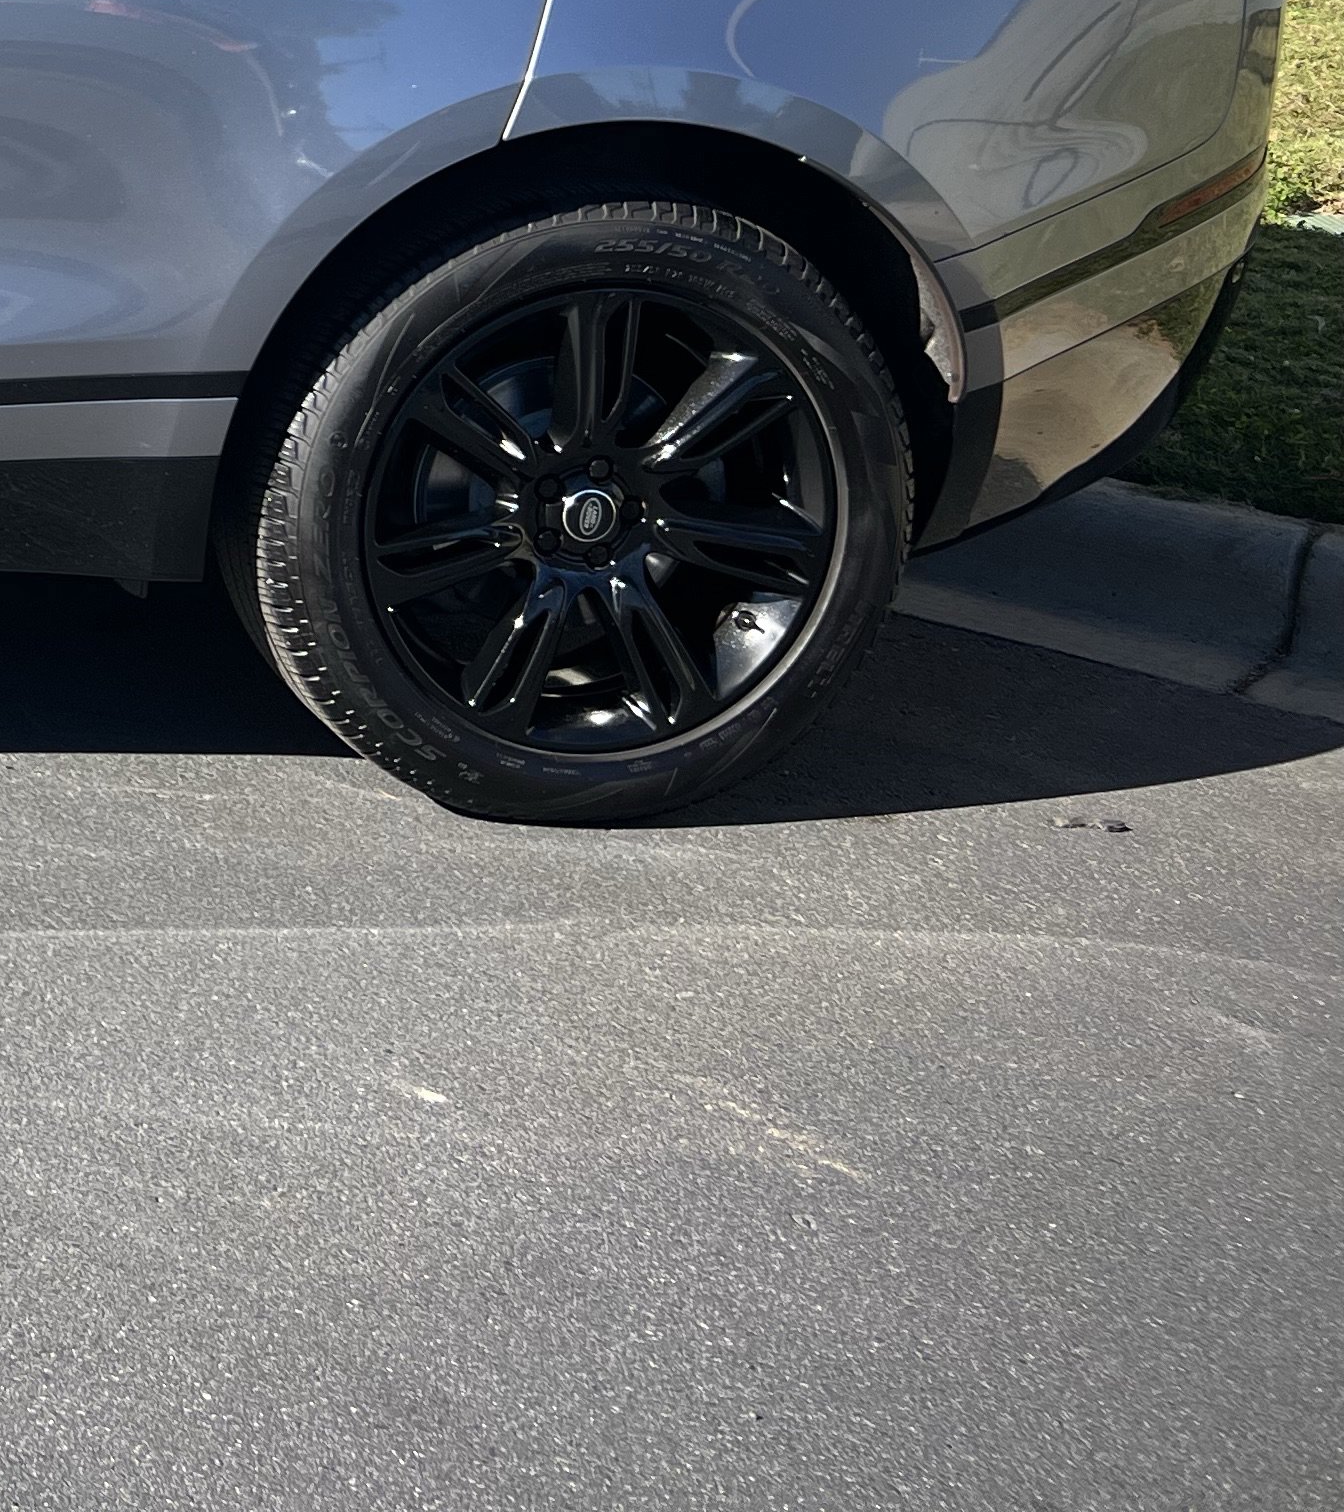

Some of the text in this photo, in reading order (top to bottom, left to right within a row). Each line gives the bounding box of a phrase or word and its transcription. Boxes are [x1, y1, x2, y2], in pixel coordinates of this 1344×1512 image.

[594, 239, 713, 263] 255/50
[312, 467, 448, 761] SCORPION ZERO
